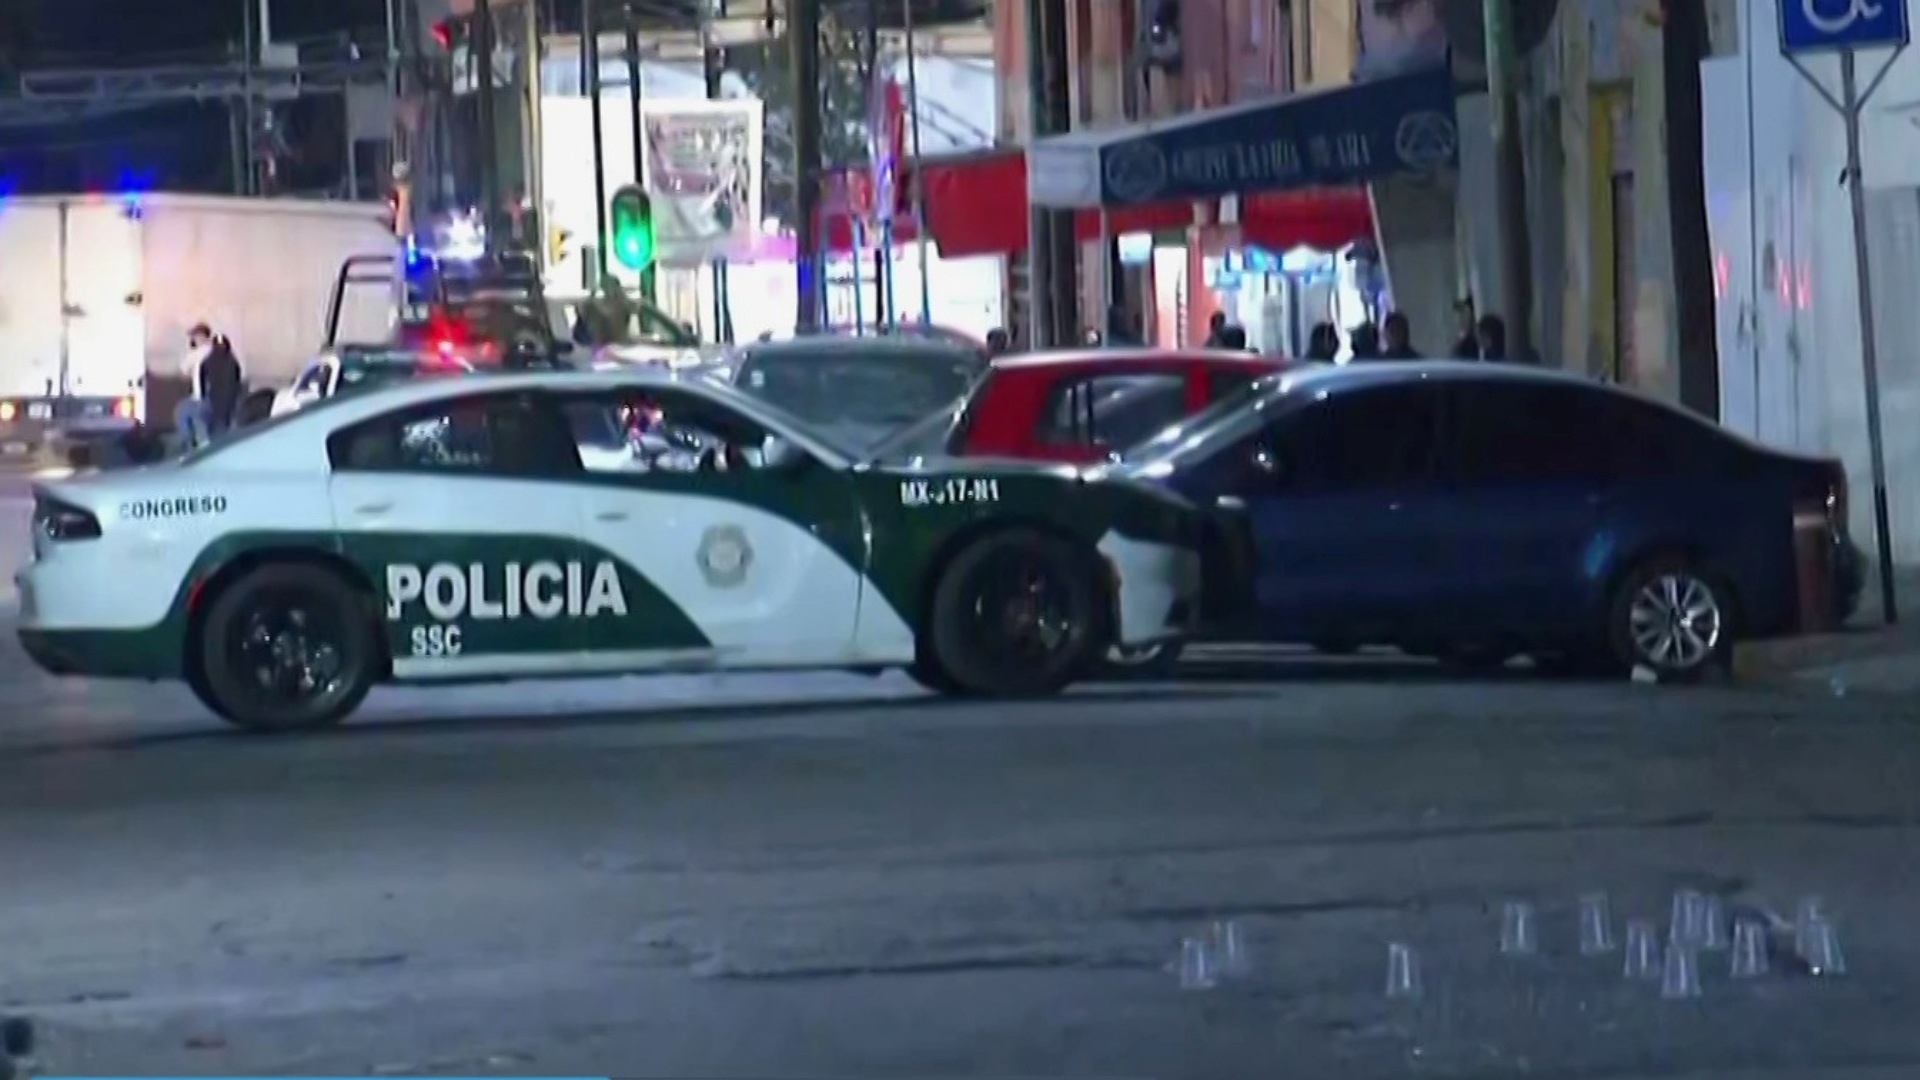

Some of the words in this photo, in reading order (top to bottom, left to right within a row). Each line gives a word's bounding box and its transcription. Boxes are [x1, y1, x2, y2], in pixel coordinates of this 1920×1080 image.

[119, 495, 228, 519] CONGRESO
[386, 559, 627, 620] POLICIA
[411, 624, 462, 656] SSC
